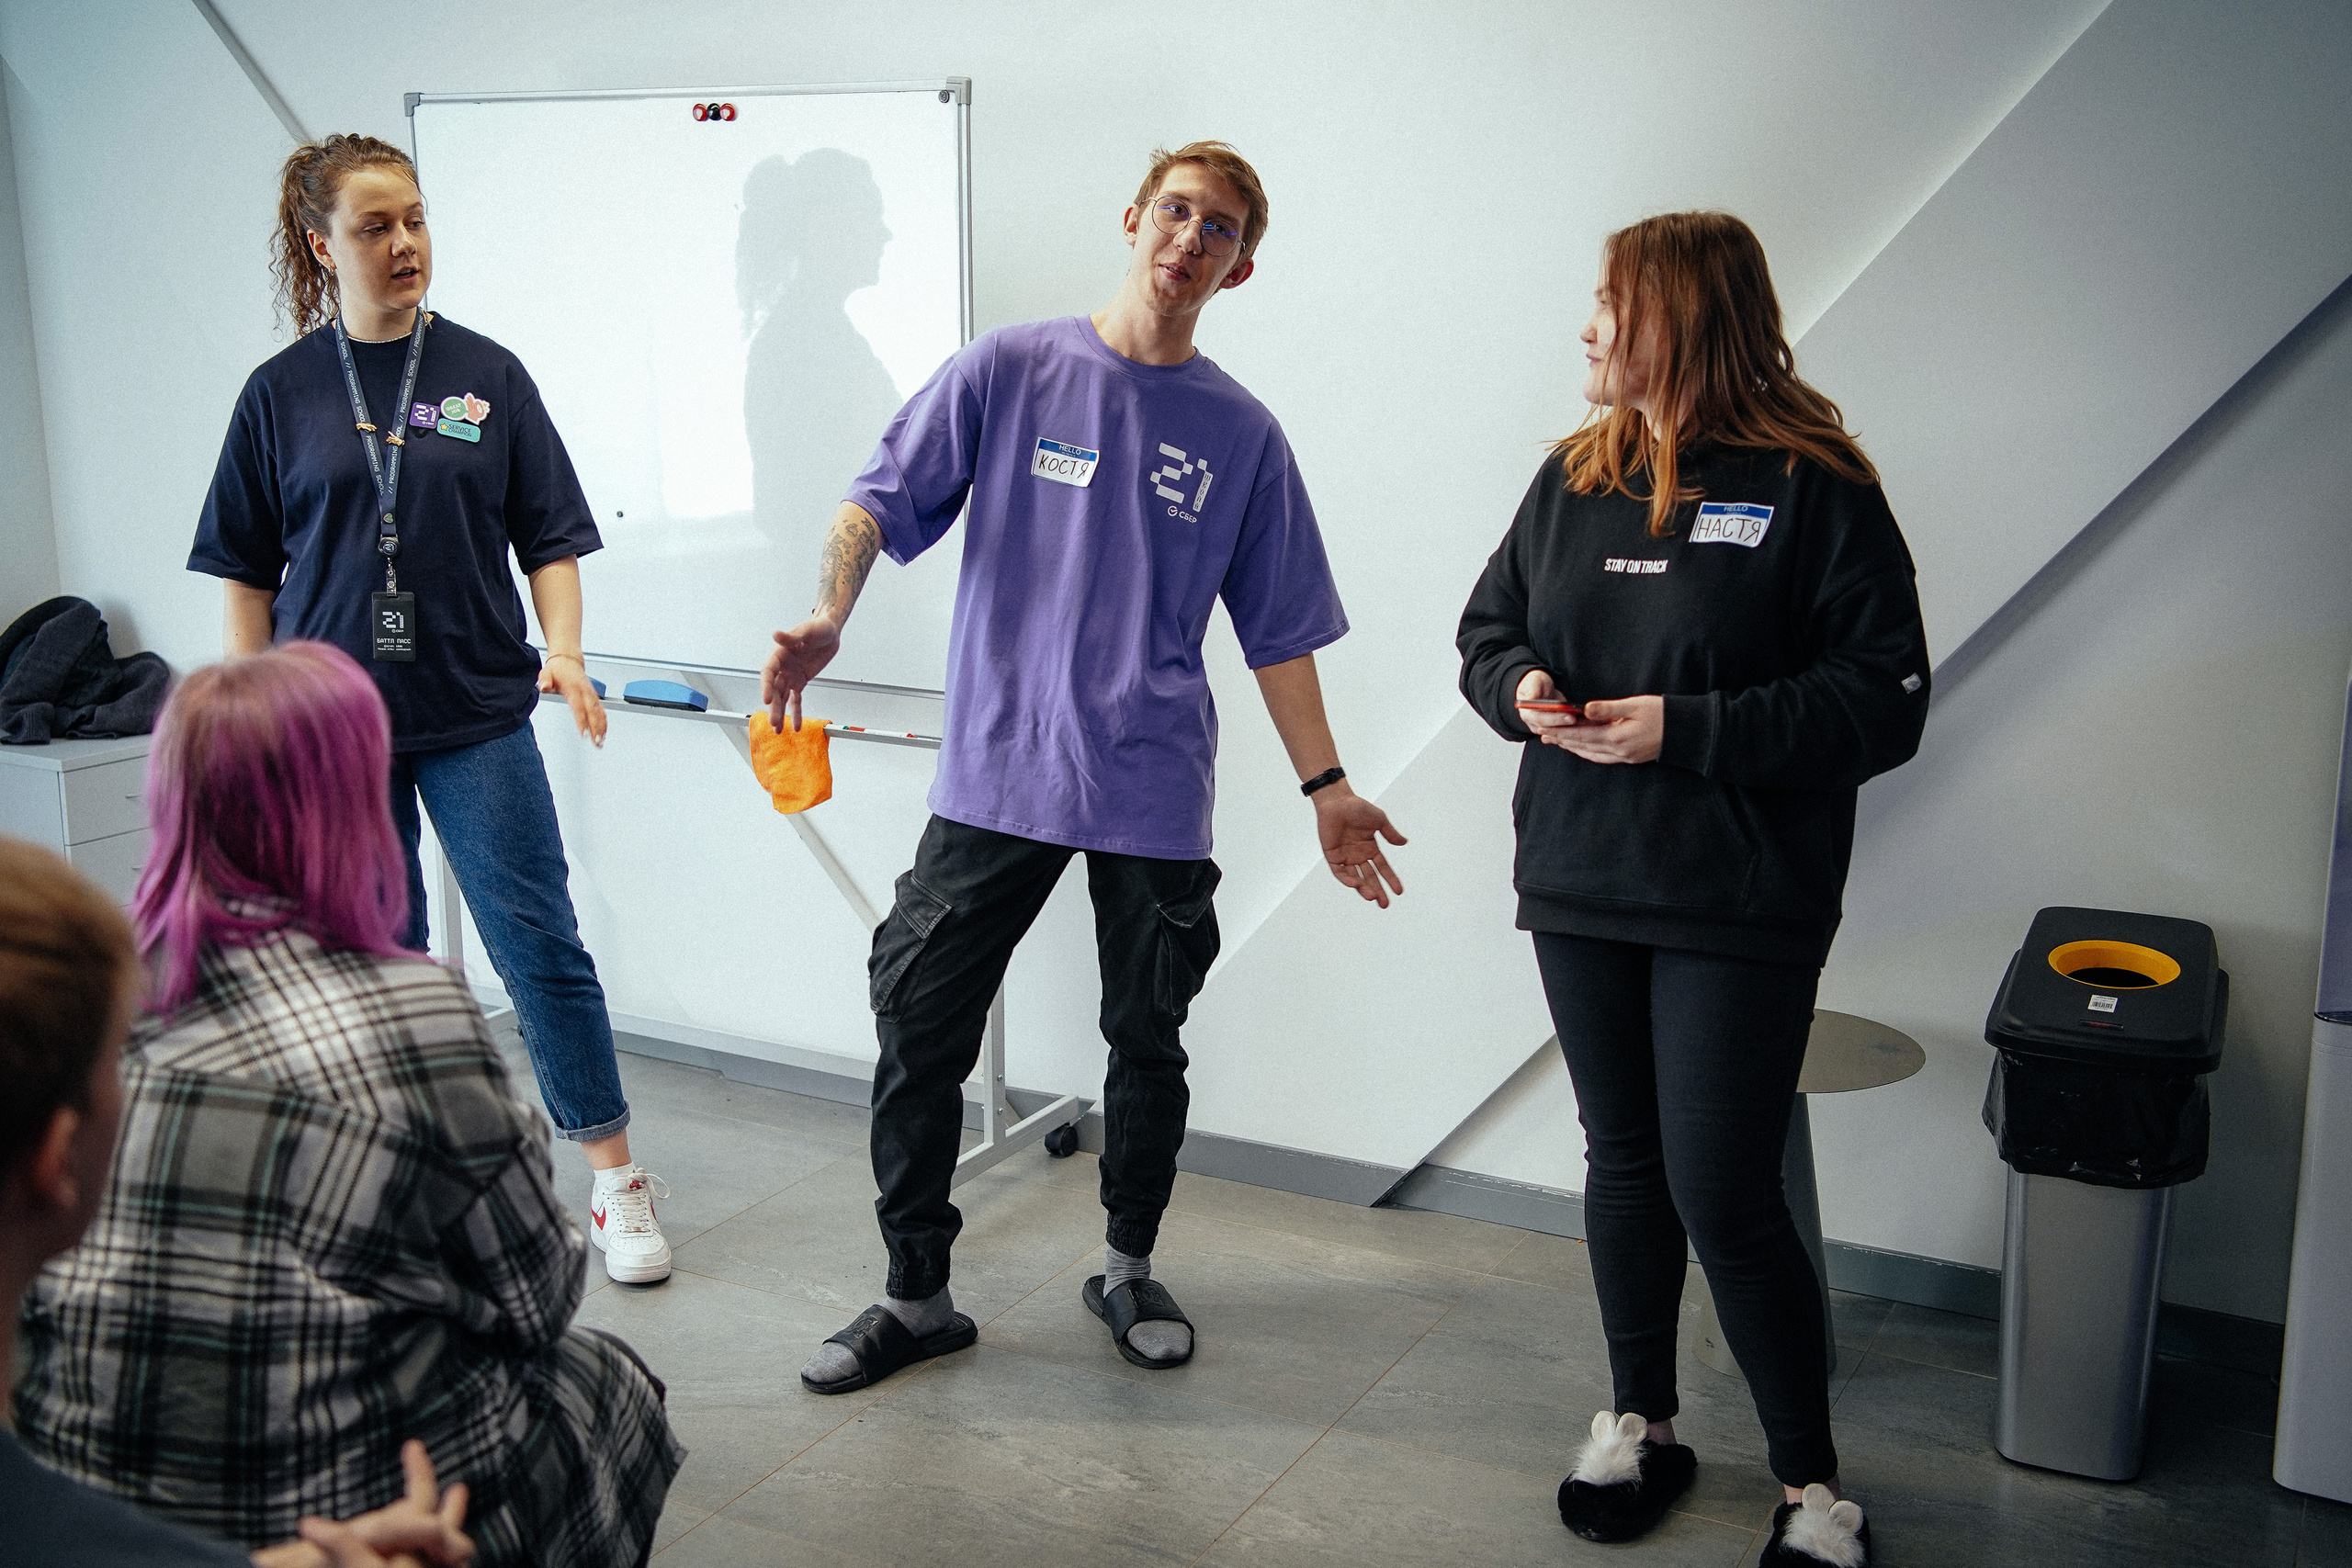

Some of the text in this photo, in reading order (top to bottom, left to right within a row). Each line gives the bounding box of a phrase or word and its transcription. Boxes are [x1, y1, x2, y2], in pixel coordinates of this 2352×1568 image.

[446, 403, 462, 412] GREAT
[389, 446, 399, 484] PROGRAMMING
[400, 378, 413, 413] PROGRAMMING
[407, 358, 416, 378] SCHOOL
[448, 423, 471, 434] SERVICE
[366, 435, 379, 472] PROGRAMMING
[1058, 444, 1081, 456] HELLO
[1038, 454, 1090, 479] КОСТЯ
[1149, 442, 1214, 513] 21
[1179, 511, 1197, 524] СБЕР
[1696, 517, 1762, 544] НАСТЯ
[1604, 558, 1668, 574] STAY ON TRACK
[382, 611, 404, 629] 21
